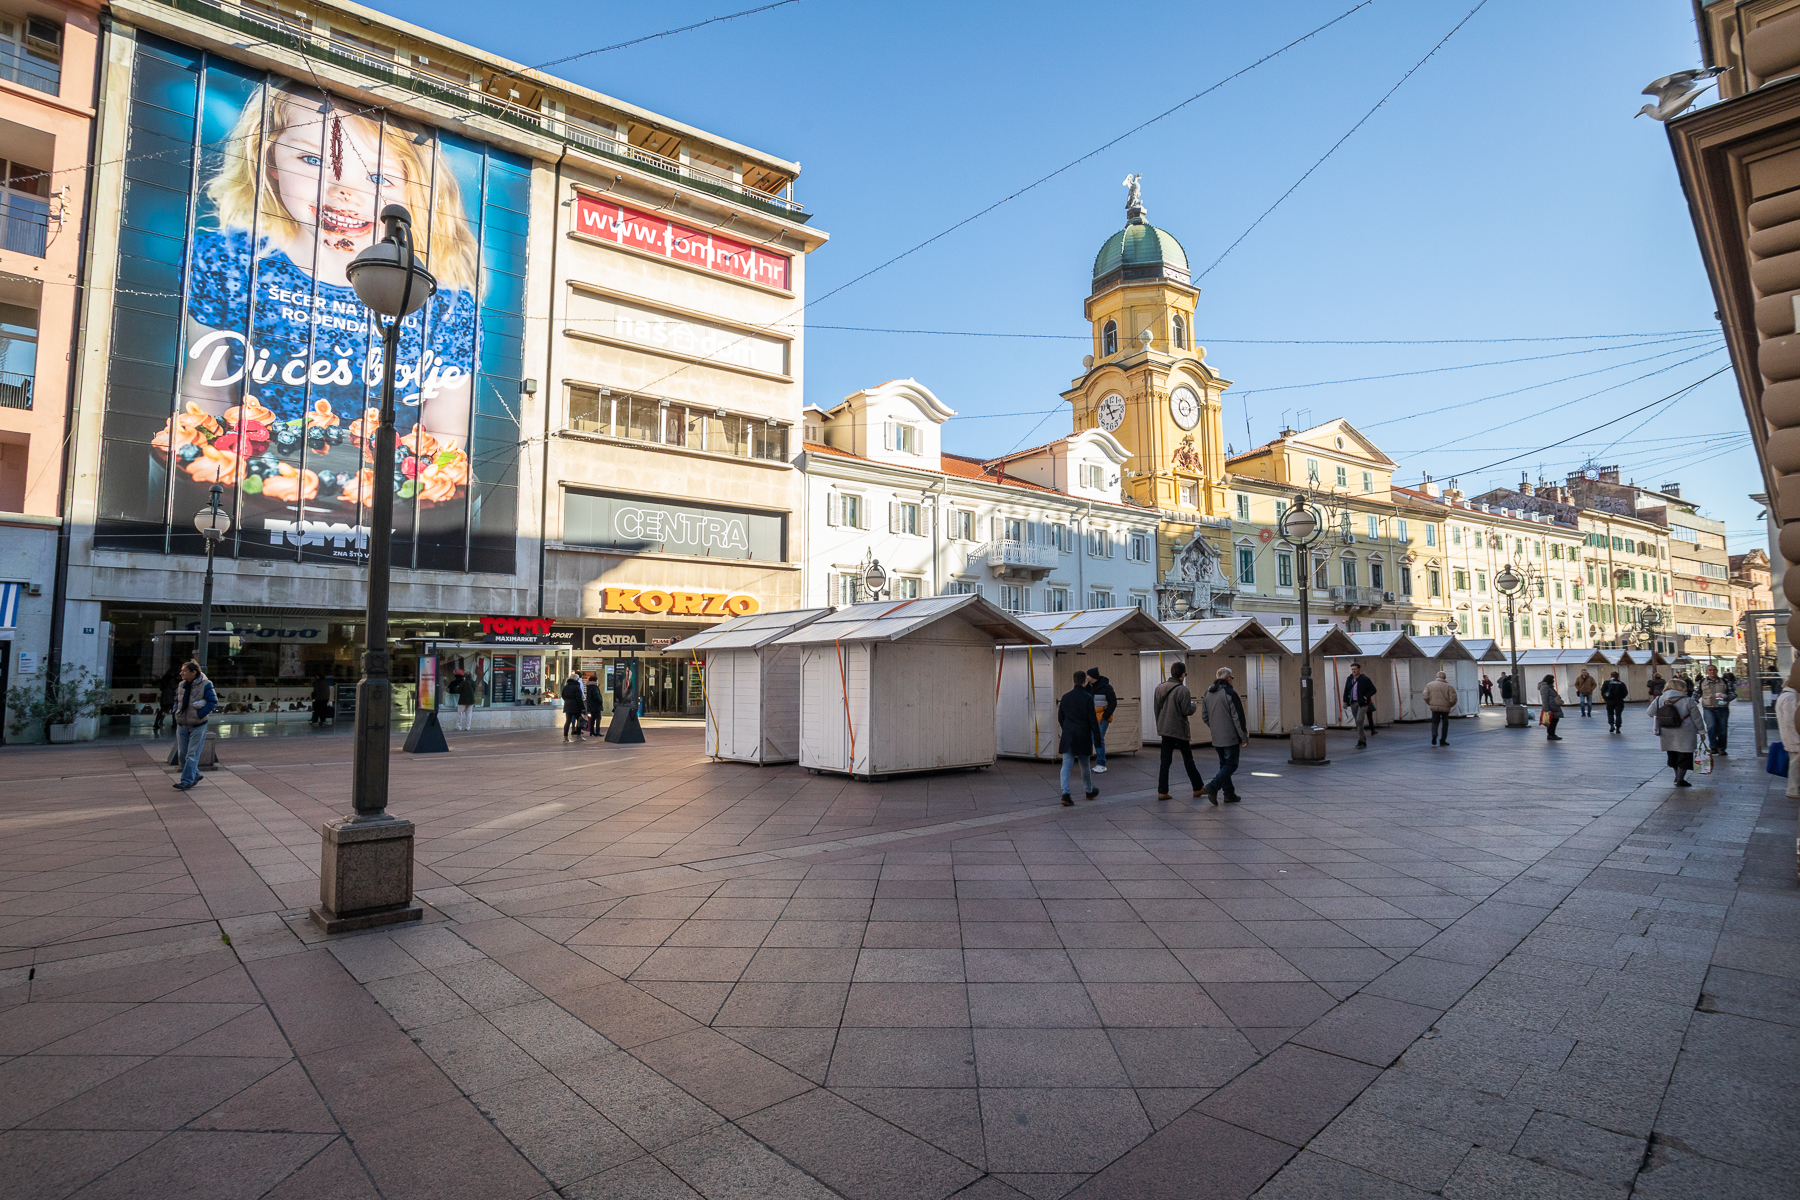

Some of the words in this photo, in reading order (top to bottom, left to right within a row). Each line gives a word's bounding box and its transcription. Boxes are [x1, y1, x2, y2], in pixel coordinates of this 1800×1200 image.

[583, 208, 783, 280] www.tommy.hr
[333, 300, 358, 317] NA
[615, 314, 668, 344] naš
[700, 331, 757, 364] dom
[189, 330, 278, 387] Di
[281, 345, 354, 386] ćeš
[361, 347, 470, 406] bolje
[264, 518, 396, 549] TOMM
[614, 507, 748, 550] CENTRA
[603, 587, 759, 616] KORZO
[480, 617, 555, 634] TOMMY
[592, 634, 638, 644] CENTRA
